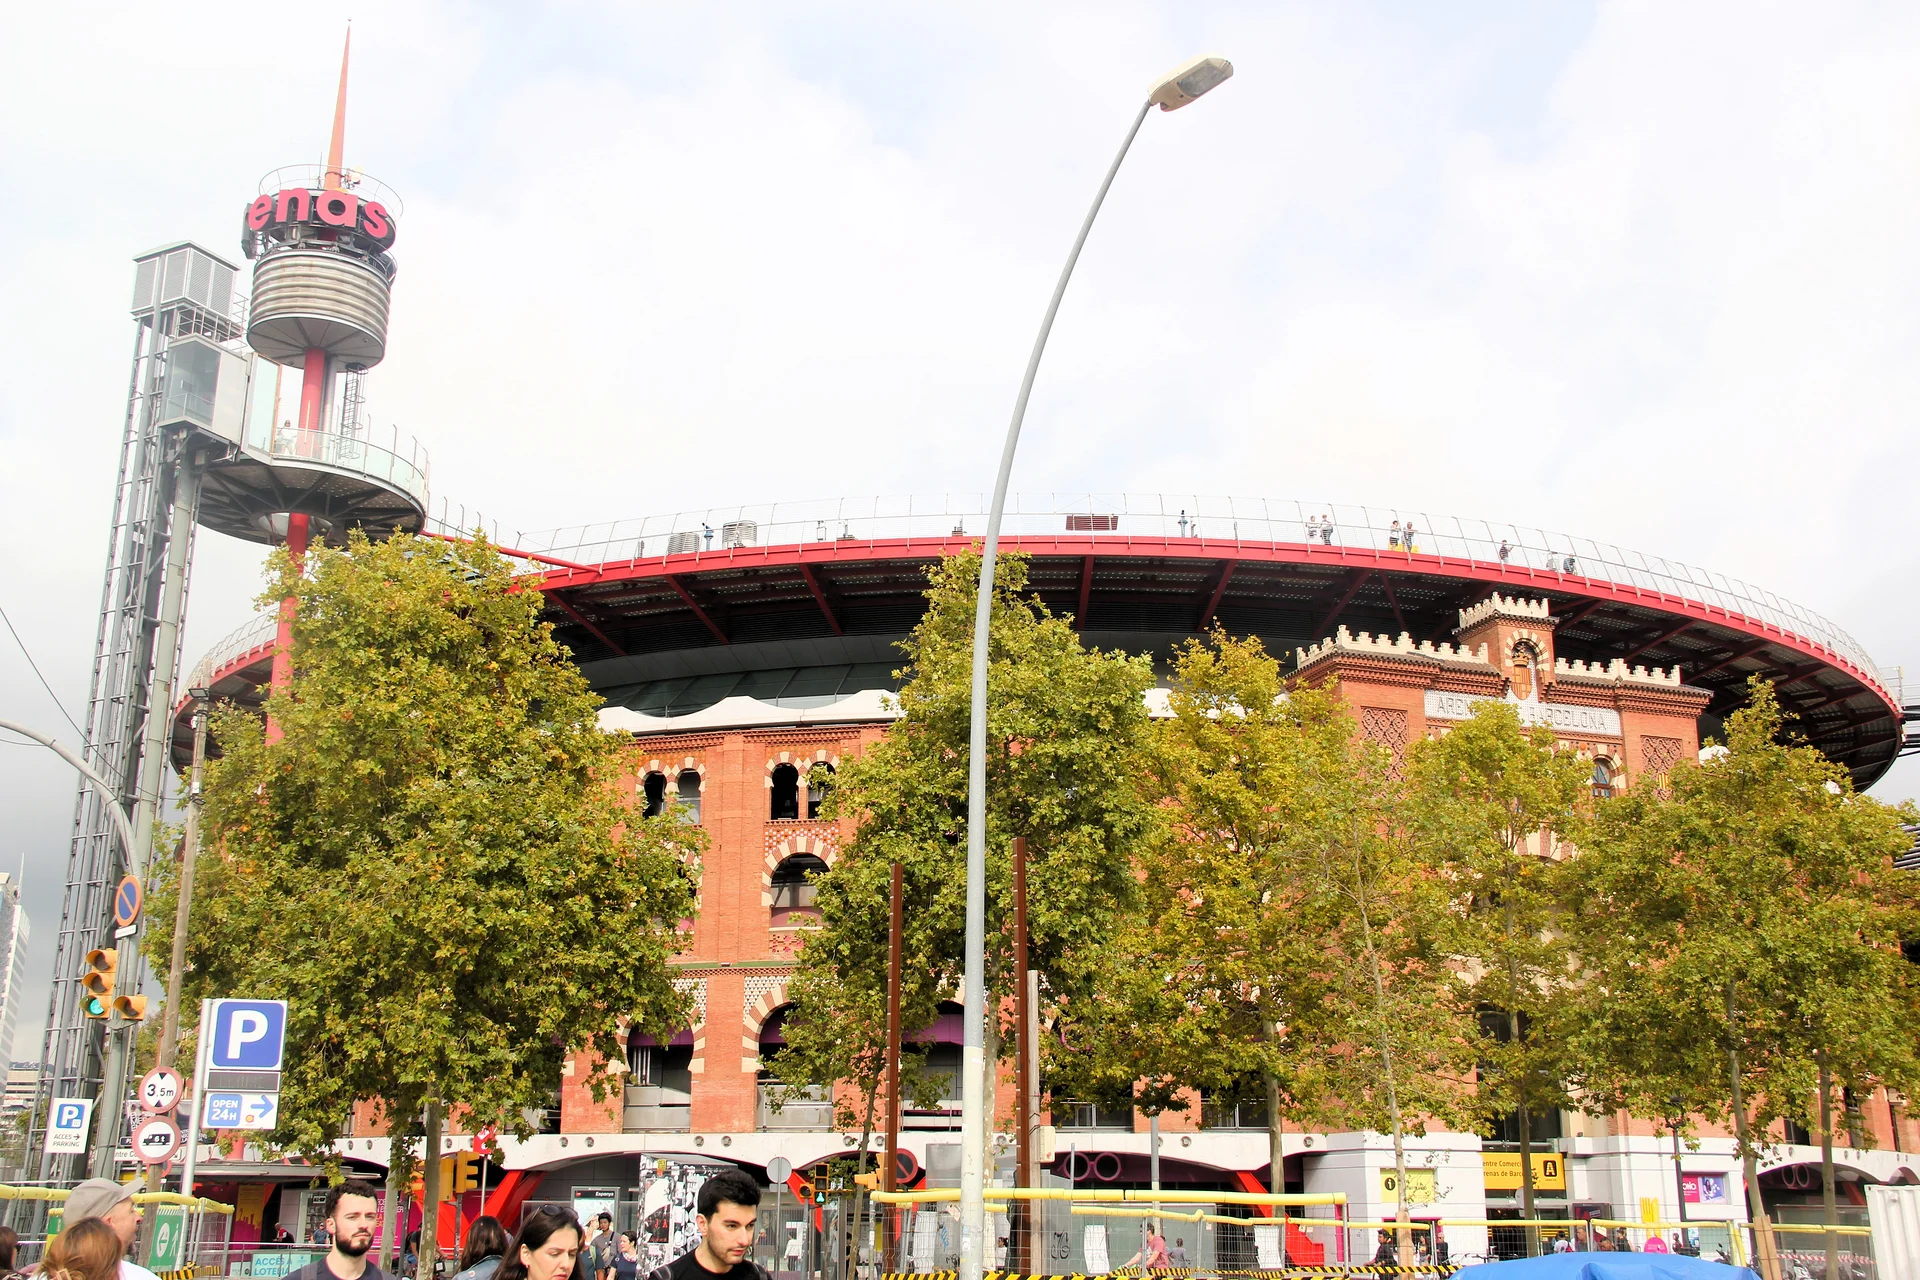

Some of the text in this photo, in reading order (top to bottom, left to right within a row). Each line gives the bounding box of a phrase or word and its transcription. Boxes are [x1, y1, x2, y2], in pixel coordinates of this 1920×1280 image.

[247, 187, 390, 240] enas
[1528, 706, 1607, 730] BARCELONA
[227, 1009, 269, 1059] P
[211, 1109, 237, 1120] 24H
[212, 1100, 238, 1108] OPEN
[61, 1105, 79, 1126] P
